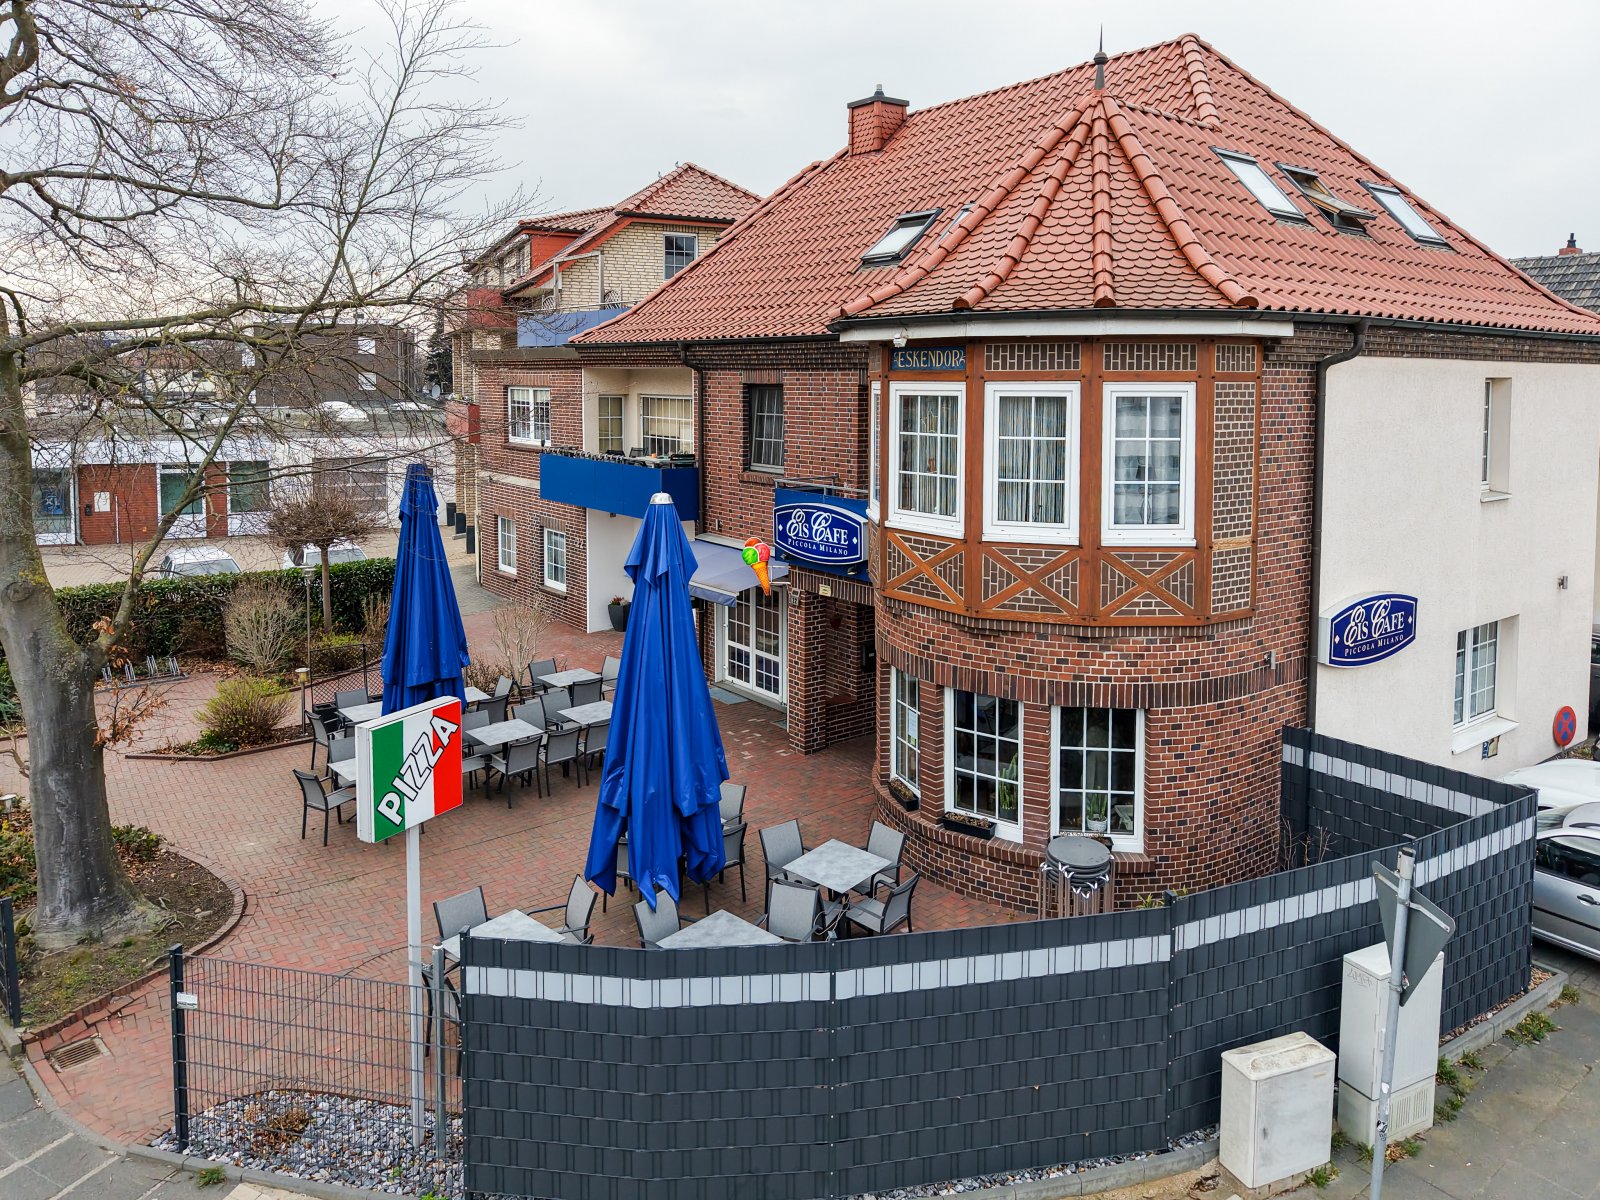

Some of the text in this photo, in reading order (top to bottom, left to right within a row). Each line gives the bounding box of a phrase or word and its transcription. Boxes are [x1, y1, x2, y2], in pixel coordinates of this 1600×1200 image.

[788, 538, 848, 556] PICCOLA MILANO
[1344, 634, 1404, 656] PICCOLA MILANO
[376, 714, 460, 827] PIZZA
